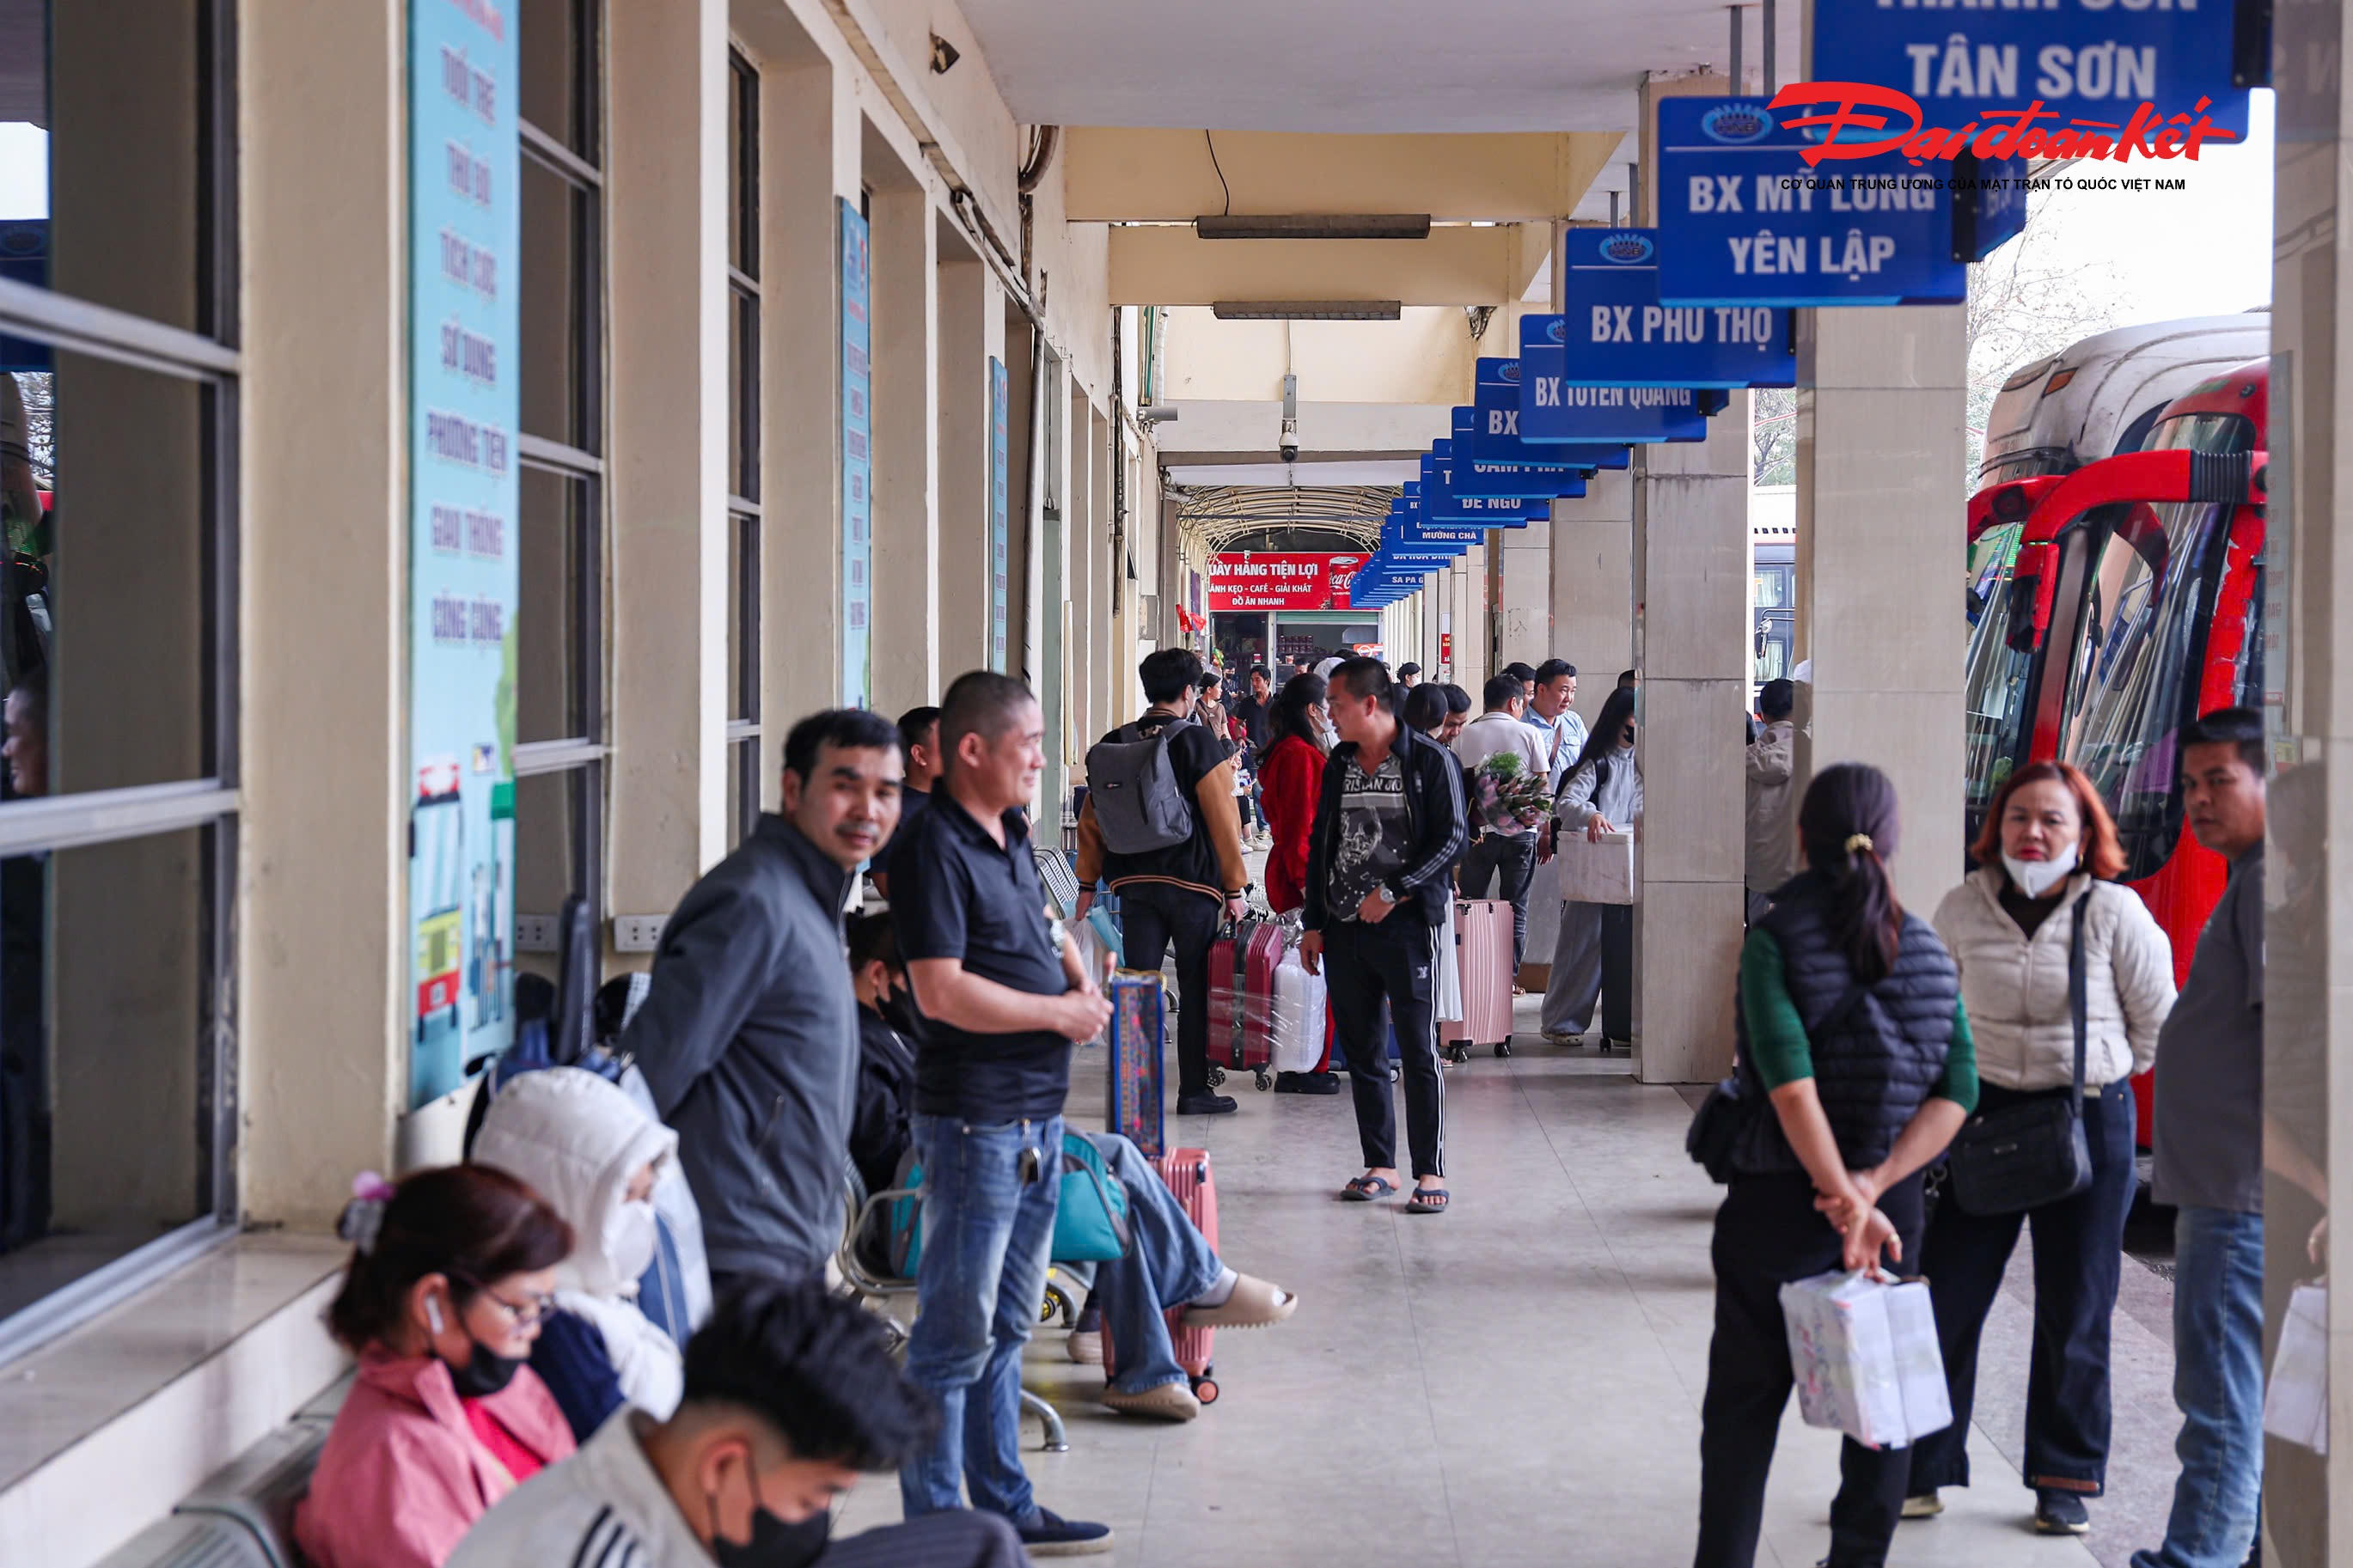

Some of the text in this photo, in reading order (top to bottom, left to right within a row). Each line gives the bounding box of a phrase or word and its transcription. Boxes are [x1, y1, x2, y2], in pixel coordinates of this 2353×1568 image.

[1906, 33, 2157, 100] TÂN SƠN
[1690, 174, 1743, 213] BX
[1830, 174, 1936, 212] LUNG
[1728, 229, 1896, 282] YÊN LẬP
[1592, 306, 1634, 343] BX
[1714, 306, 1773, 351] THỌ
[1536, 376, 1562, 406] BX
[1488, 410, 1519, 436] BX
[1208, 558, 1318, 579] UẦY HÀNG TIỆN LỢI
[1208, 583, 1226, 593] ÁNH
[1228, 585, 1243, 595] KẸO
[1250, 583, 1268, 593] CAFÉ
[1275, 583, 1290, 593] GIẢI
[1293, 583, 1312, 593] KHÁT
[1232, 595, 1285, 606] ĐỒ ĂN NHANH
